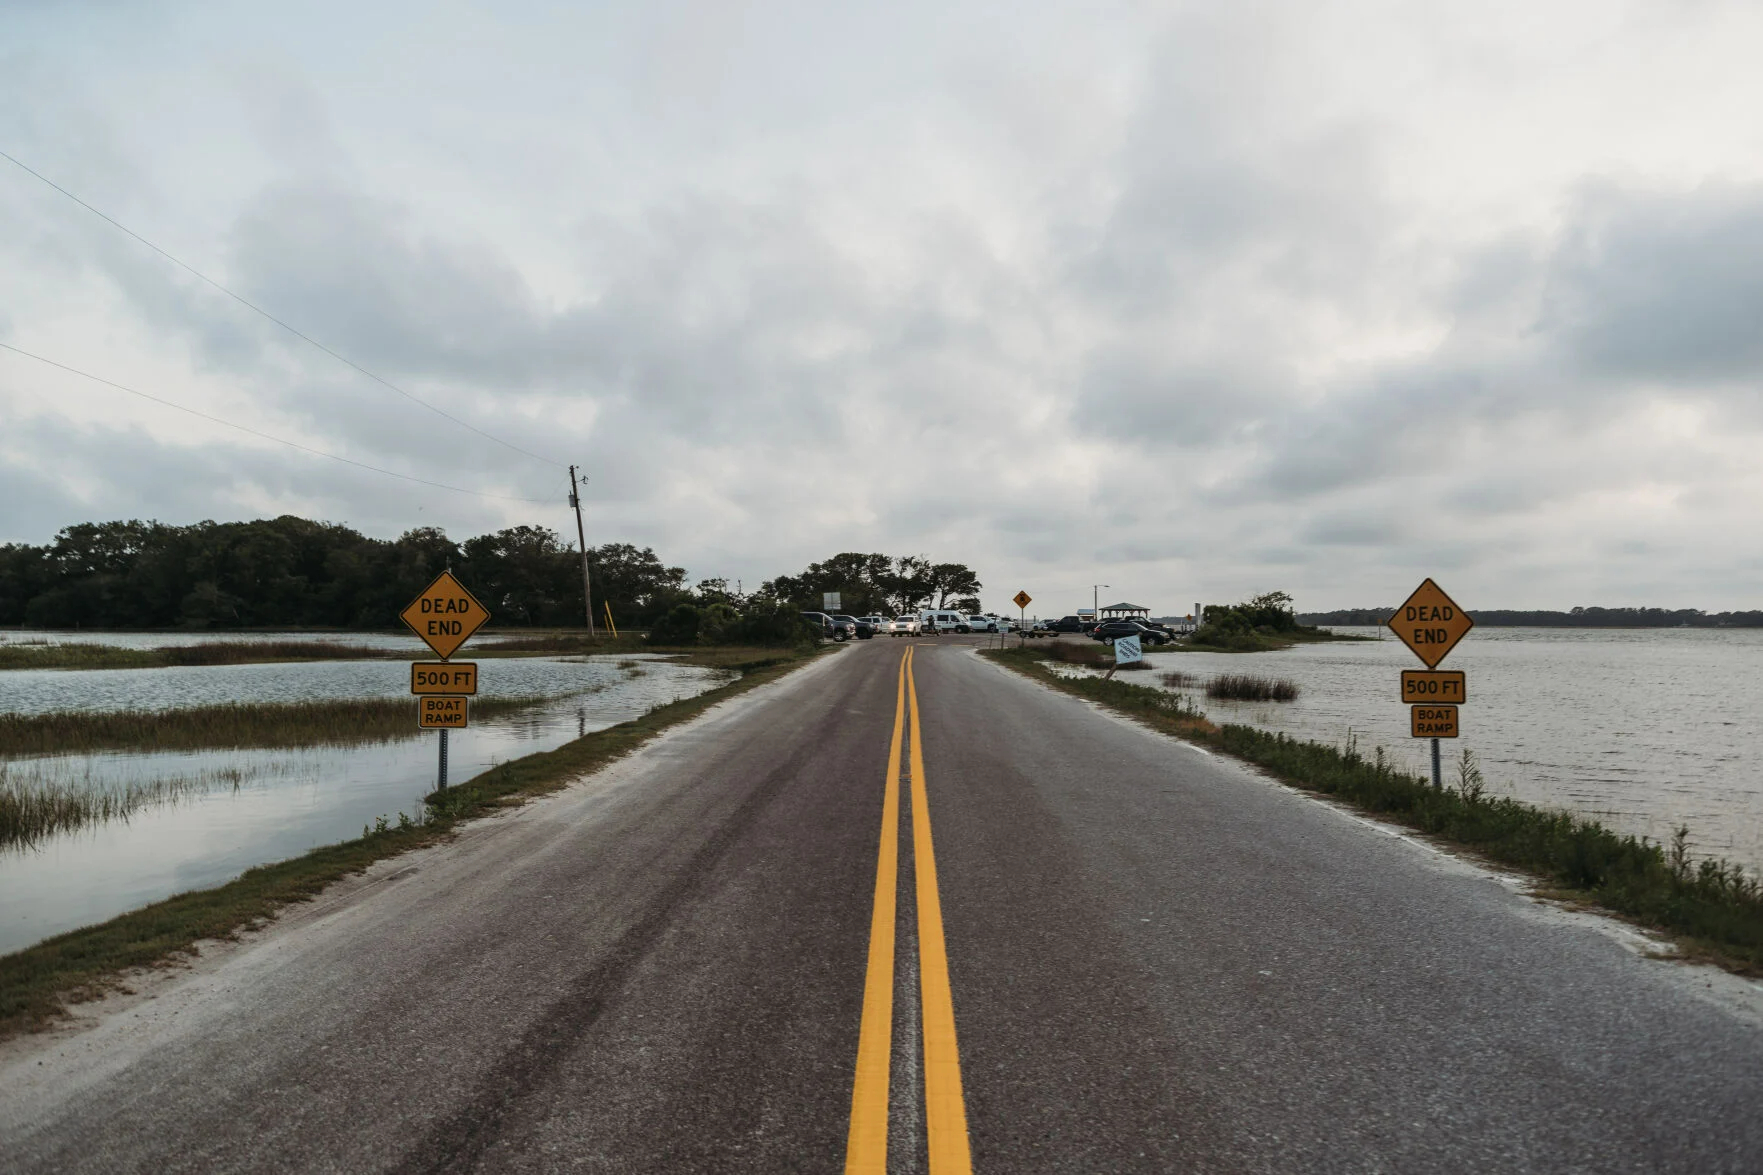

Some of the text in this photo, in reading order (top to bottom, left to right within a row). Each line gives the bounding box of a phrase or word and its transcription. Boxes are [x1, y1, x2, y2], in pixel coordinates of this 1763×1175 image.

[421, 599, 469, 613] DEAD
[1406, 606, 1453, 621] DEAD
[427, 621, 462, 635] END
[1414, 629, 1448, 644] END
[417, 672, 471, 685] 500 FT
[1407, 680, 1460, 694] 500 FT
[427, 701, 461, 711] BOAT
[425, 714, 463, 724] RAMP
[1418, 710, 1452, 720] BOAT
[1417, 723, 1453, 733] RAMP
